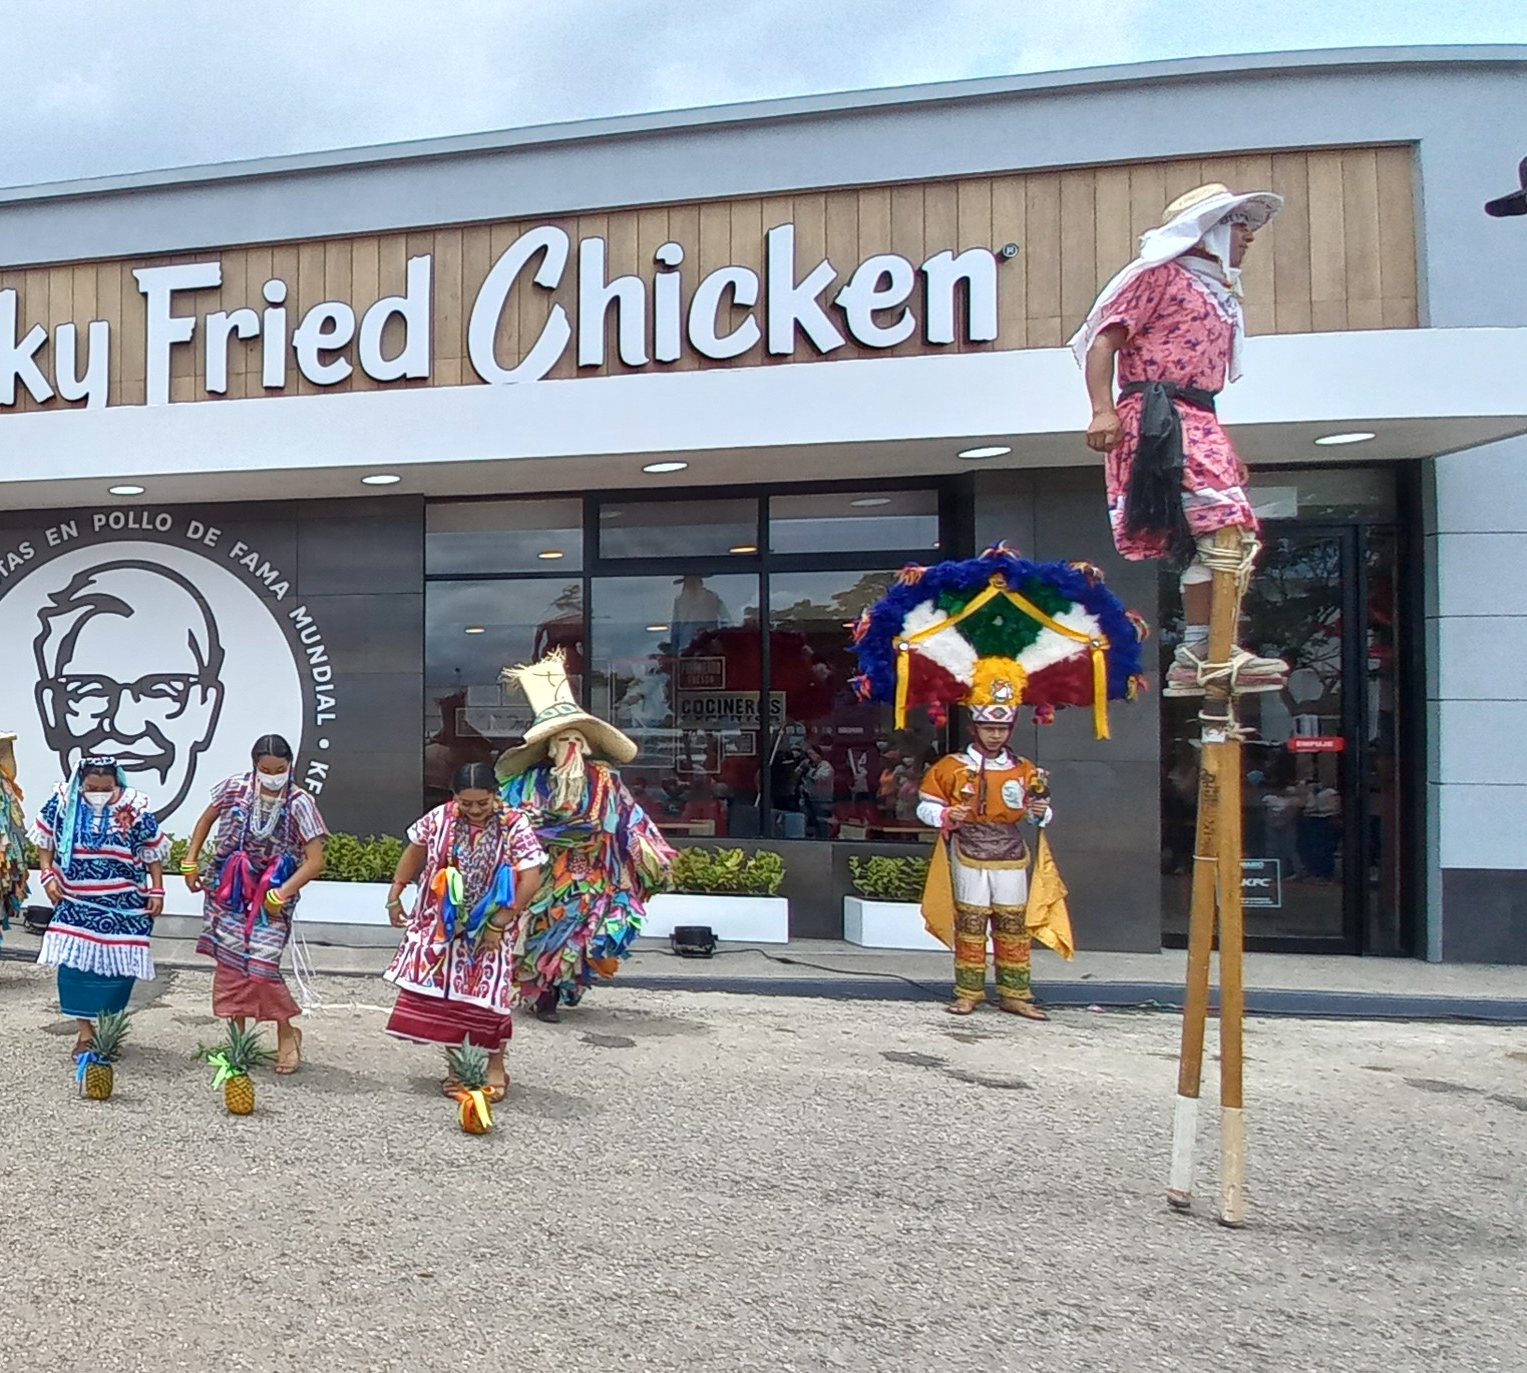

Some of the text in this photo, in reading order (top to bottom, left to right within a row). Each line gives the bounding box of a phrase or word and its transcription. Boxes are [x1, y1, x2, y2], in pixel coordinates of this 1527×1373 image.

[131, 253, 432, 406] Fried
[467, 222, 998, 385] Chicken
[45, 520, 79, 547] EN
[93, 510, 173, 532] POLLO
[186, 520, 222, 547] DE
[228, 541, 292, 601] FAMA
[288, 605, 336, 726] MUNDIAL
[681, 698, 782, 715] COCINERS
[1295, 740, 1335, 748] EMPUJE
[304, 760, 330, 795] KF
